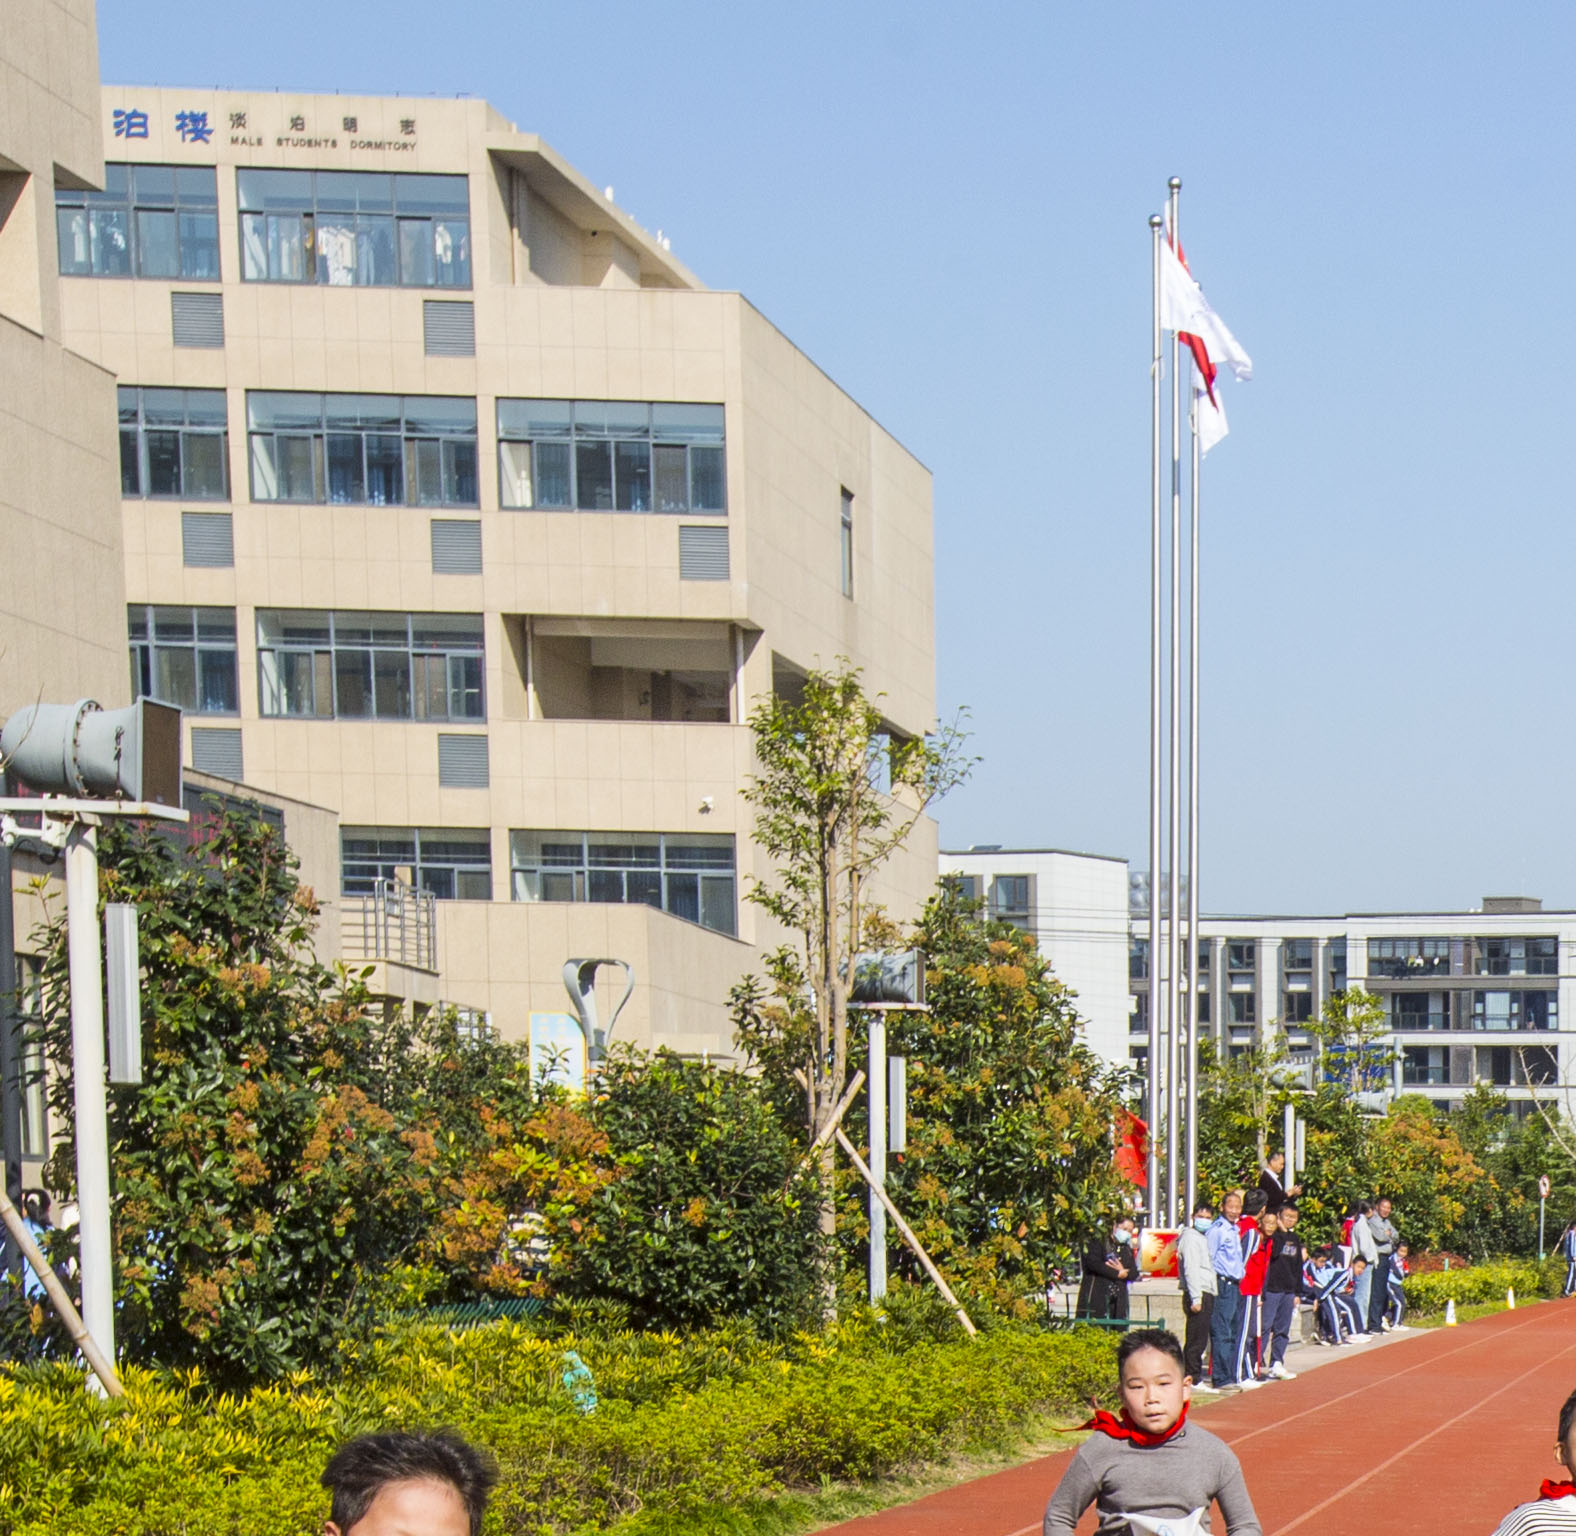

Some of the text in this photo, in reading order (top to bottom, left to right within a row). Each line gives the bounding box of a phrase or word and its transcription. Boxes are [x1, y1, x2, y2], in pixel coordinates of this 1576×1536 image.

[230, 137, 417, 152] MALE STUDENTS DORMITORY
